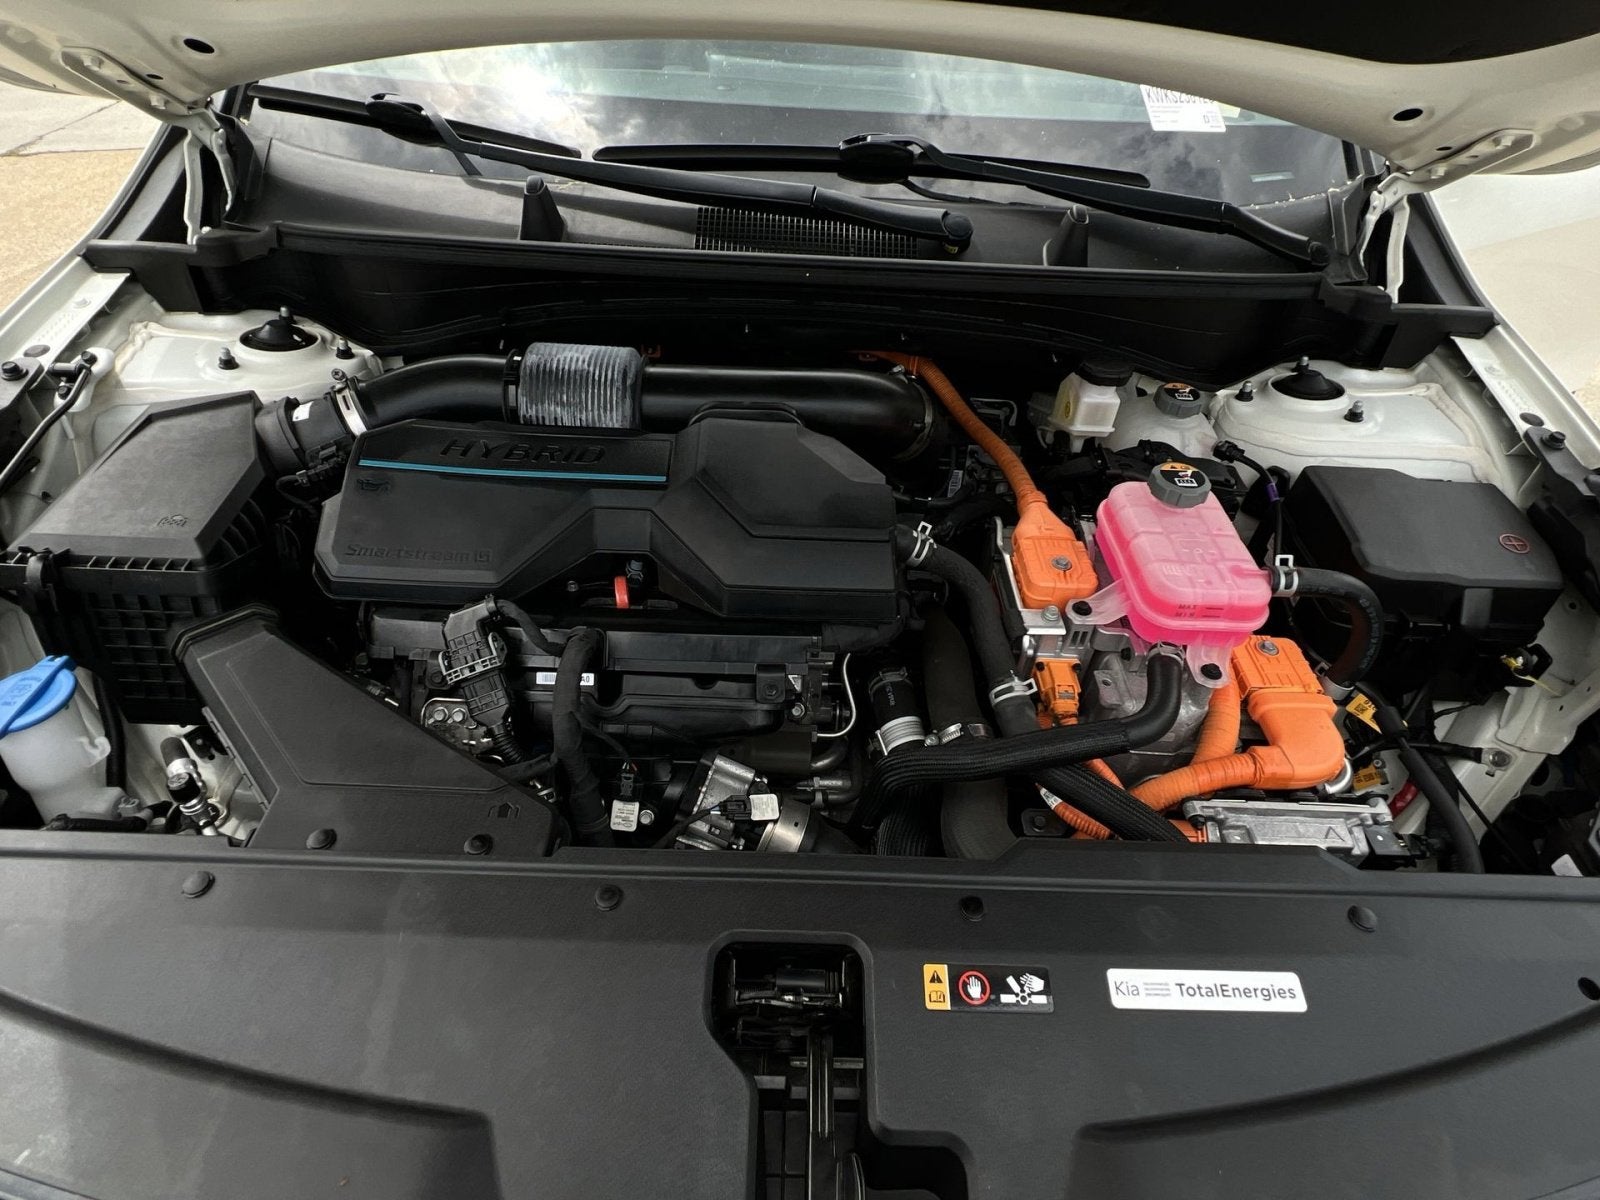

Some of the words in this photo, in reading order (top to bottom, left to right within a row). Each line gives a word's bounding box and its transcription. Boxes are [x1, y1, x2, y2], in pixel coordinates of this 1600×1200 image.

[440, 439, 606, 464] HYBRID
[344, 543, 471, 563] Smartstream
[1114, 979, 1140, 997] Kia
[1175, 982, 1297, 1002] TotalEnergies
